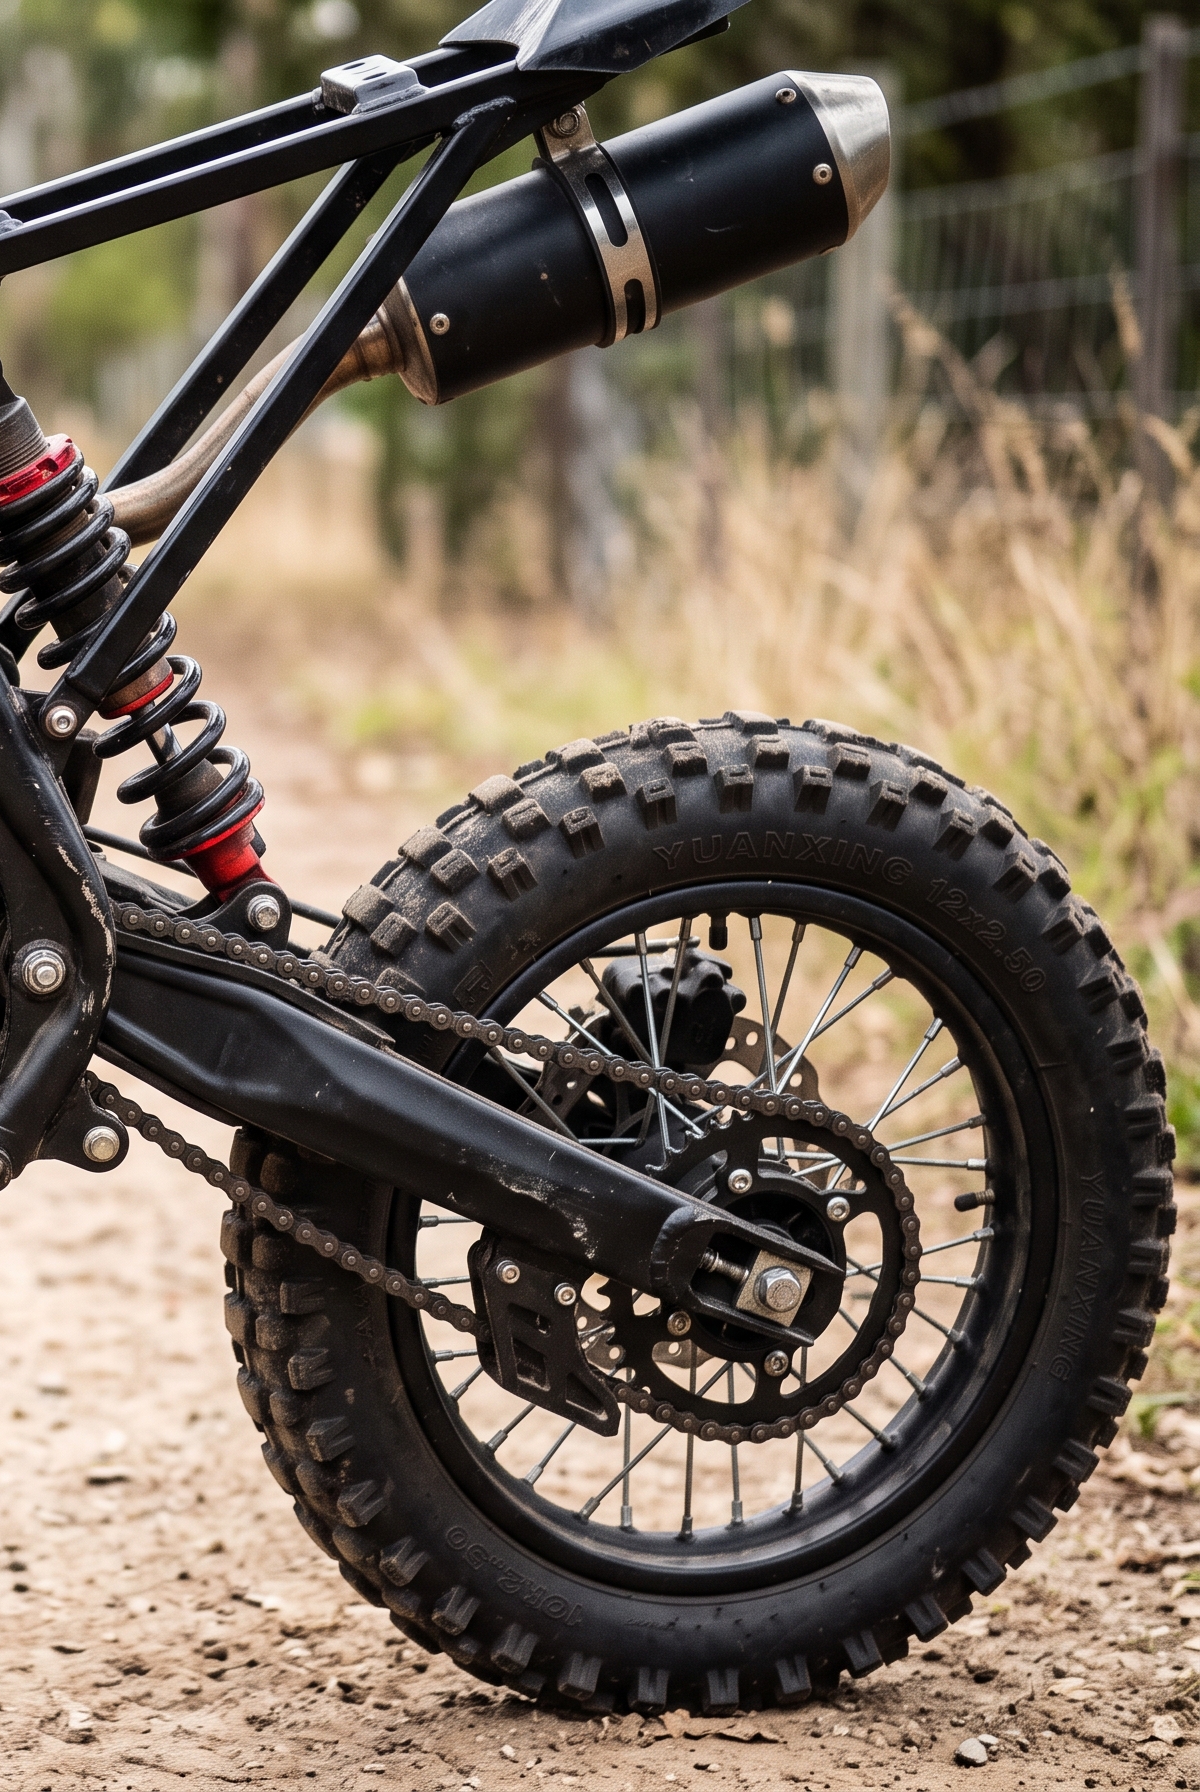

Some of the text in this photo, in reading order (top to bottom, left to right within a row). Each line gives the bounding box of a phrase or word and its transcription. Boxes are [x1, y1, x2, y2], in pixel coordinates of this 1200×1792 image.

[653, 830, 1048, 994] YUANXING 12x2.50
[1048, 1170, 1105, 1384] YUANXING
